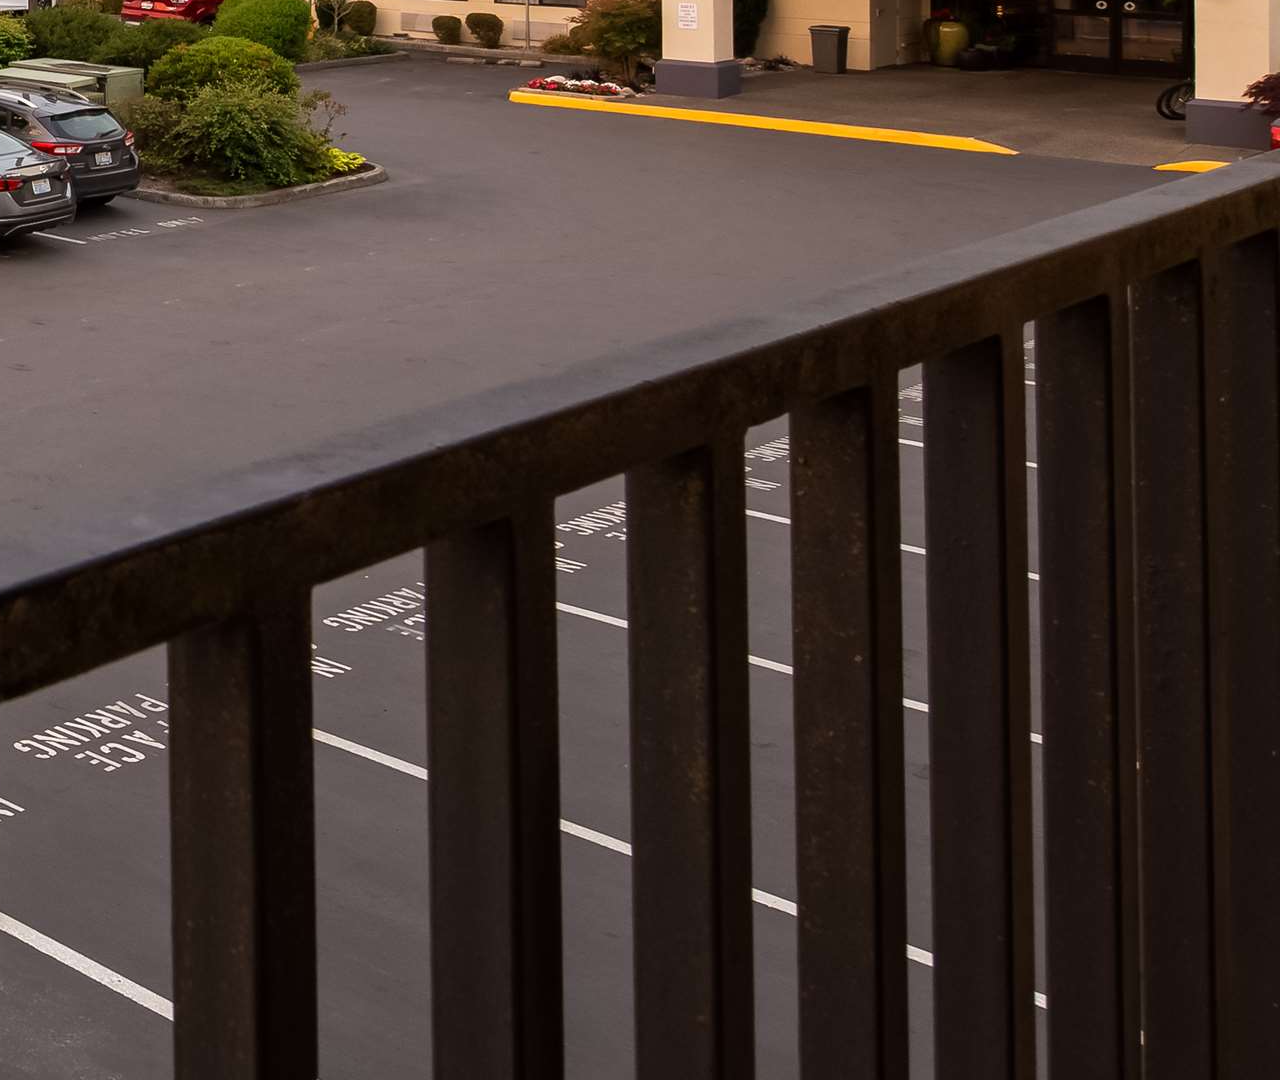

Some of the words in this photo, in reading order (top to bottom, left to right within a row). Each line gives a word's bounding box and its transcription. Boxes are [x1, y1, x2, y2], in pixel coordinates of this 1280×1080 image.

[87, 226, 150, 242] HOTEL
[157, 215, 205, 229] ONLY
[322, 581, 425, 631] ARKING
[13, 692, 169, 760] PARKING
